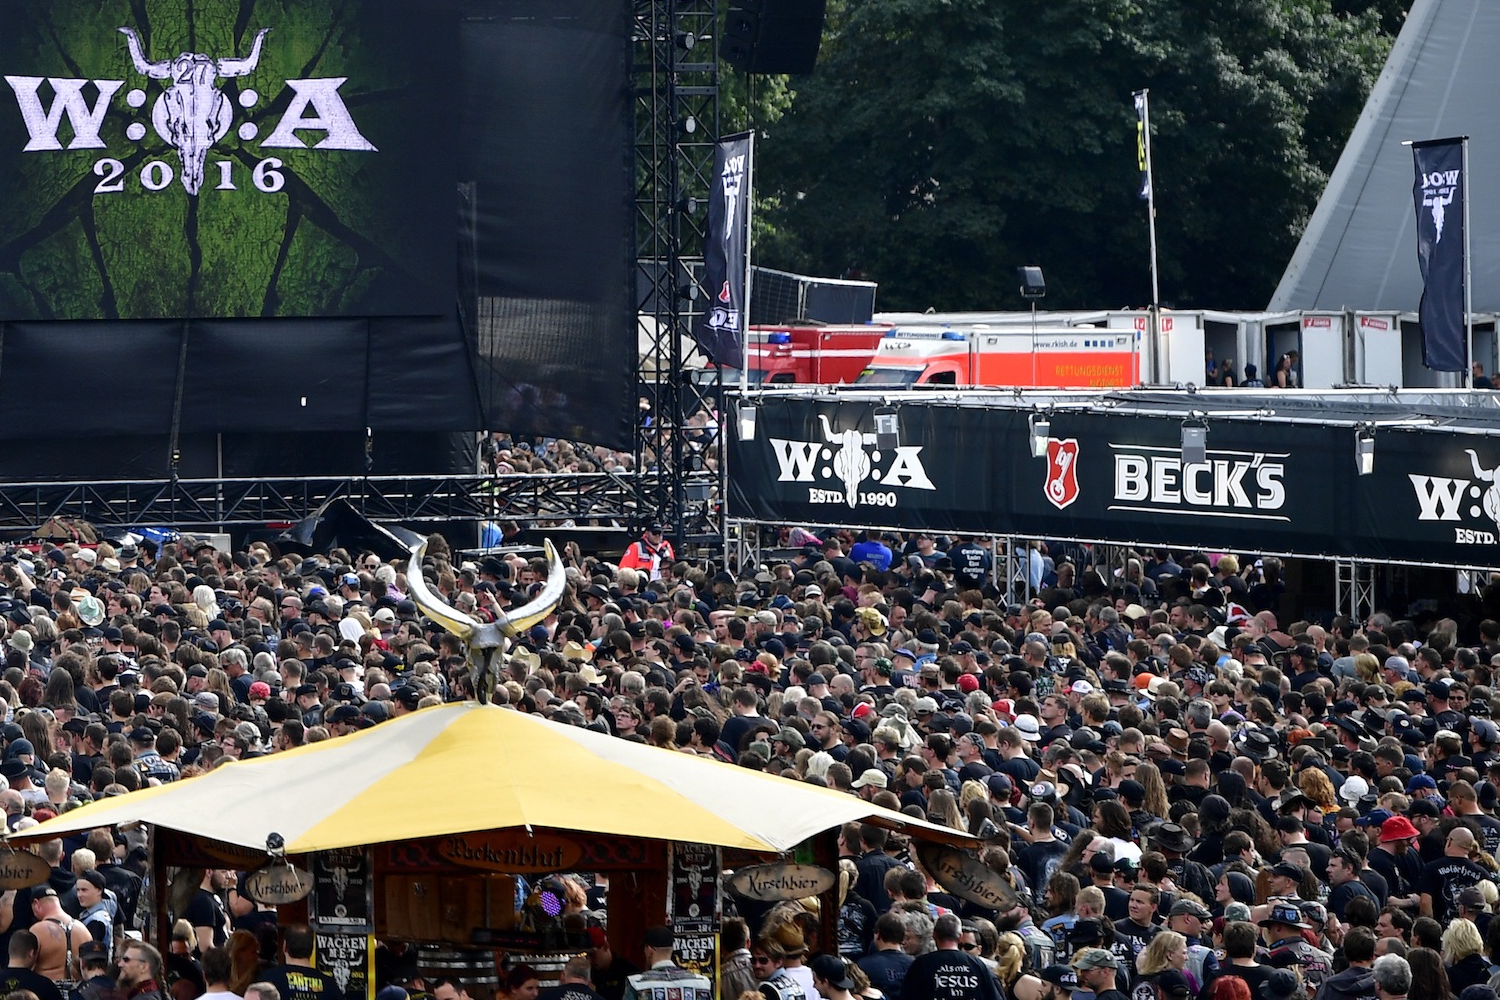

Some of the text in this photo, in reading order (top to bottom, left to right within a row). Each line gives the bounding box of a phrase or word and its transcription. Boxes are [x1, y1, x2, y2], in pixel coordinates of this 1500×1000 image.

[1033, 339, 1079, 350] www.rkish.de
[1113, 452, 1287, 509] BECK'S
[808, 487, 897, 508] ESTD. 1990
[1454, 527, 1498, 545] ESTD.
[749, 871, 819, 895] Kirschbier
[931, 850, 1003, 905] Kirschbier
[316, 934, 367, 951] WACKEN
[673, 936, 715, 950] WACKEN
[328, 948, 358, 960] MET
[681, 948, 707, 960] MET
